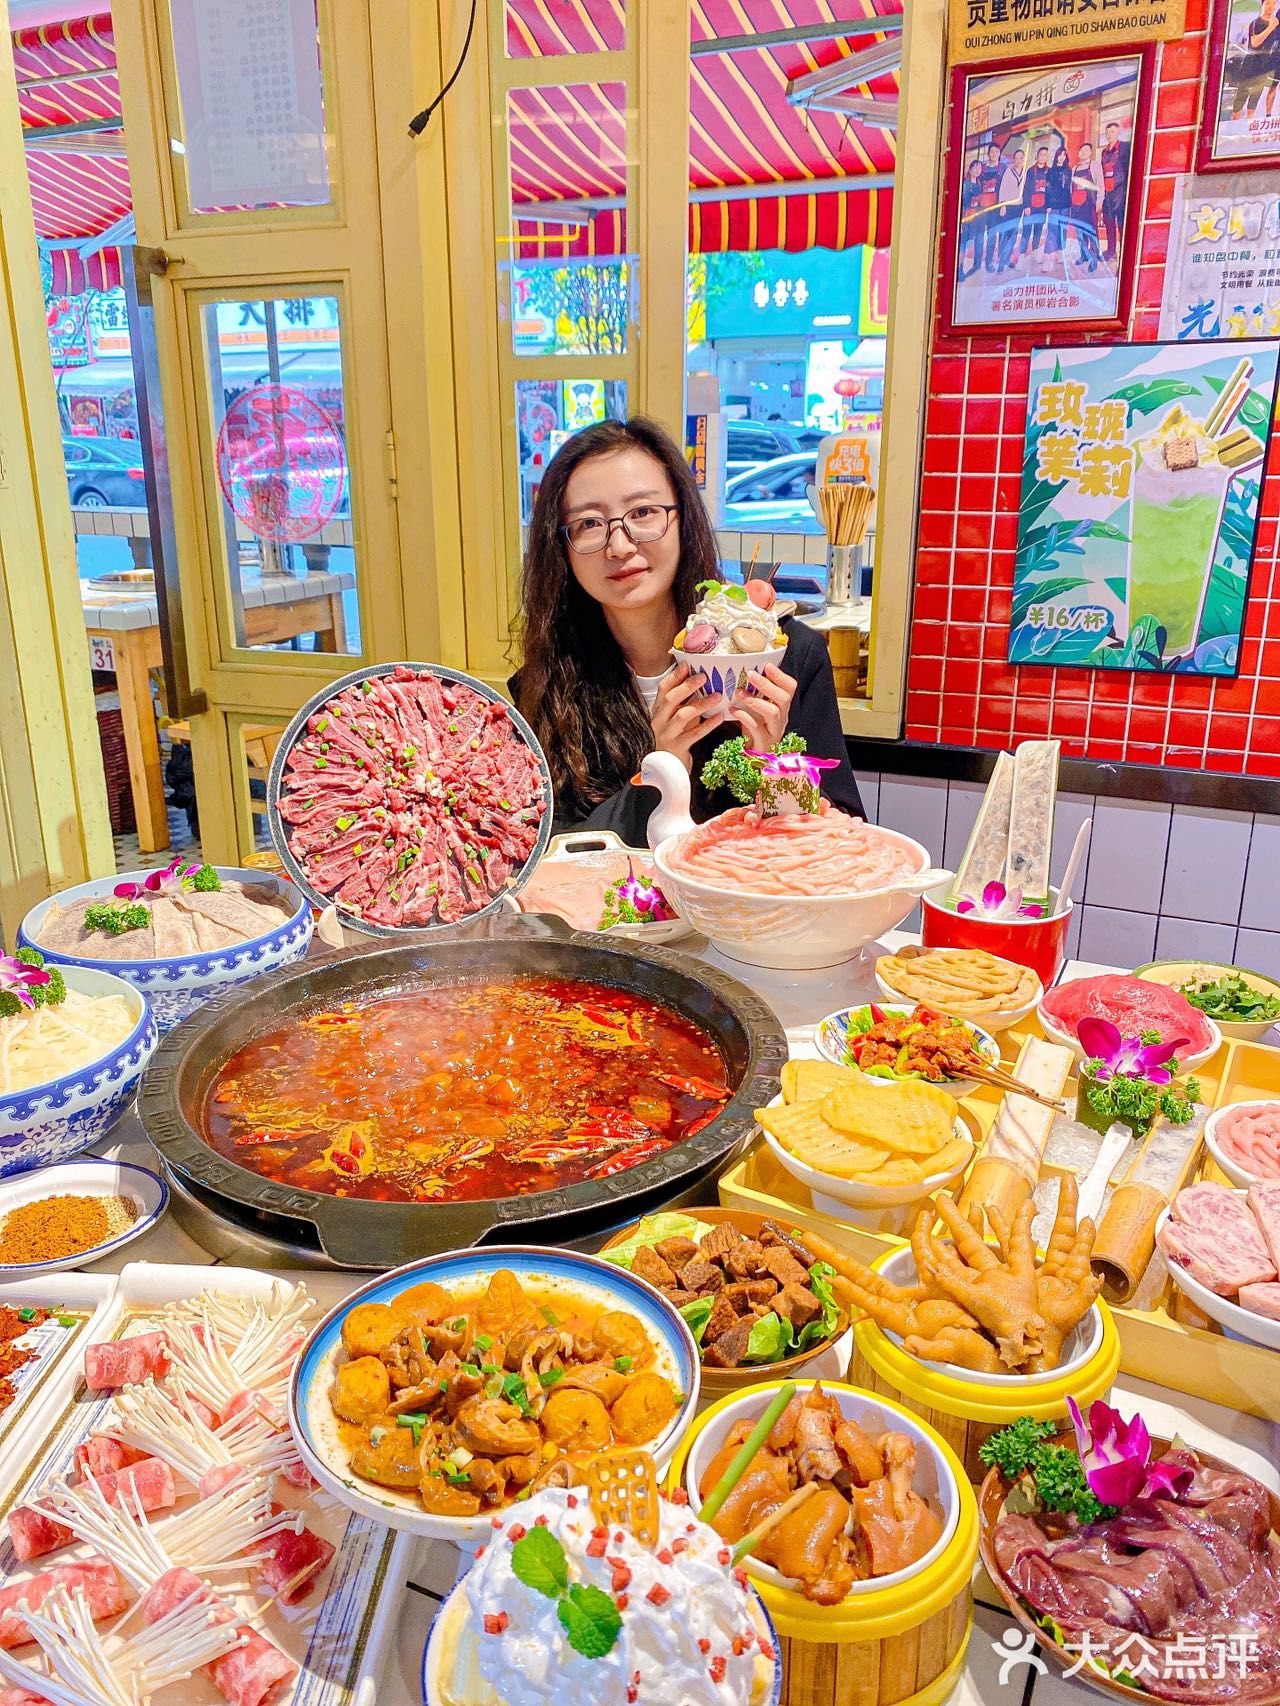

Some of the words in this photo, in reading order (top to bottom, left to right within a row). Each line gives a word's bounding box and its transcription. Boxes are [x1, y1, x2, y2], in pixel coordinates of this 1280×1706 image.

[1046, 25, 1068, 38] QING
[1070, 22, 1089, 35] TUO
[1090, 18, 1117, 33] SHAN
[1117, 16, 1138, 29] BAO
[1139, 12, 1167, 27] GUAN
[94, 648, 114, 670] 31
